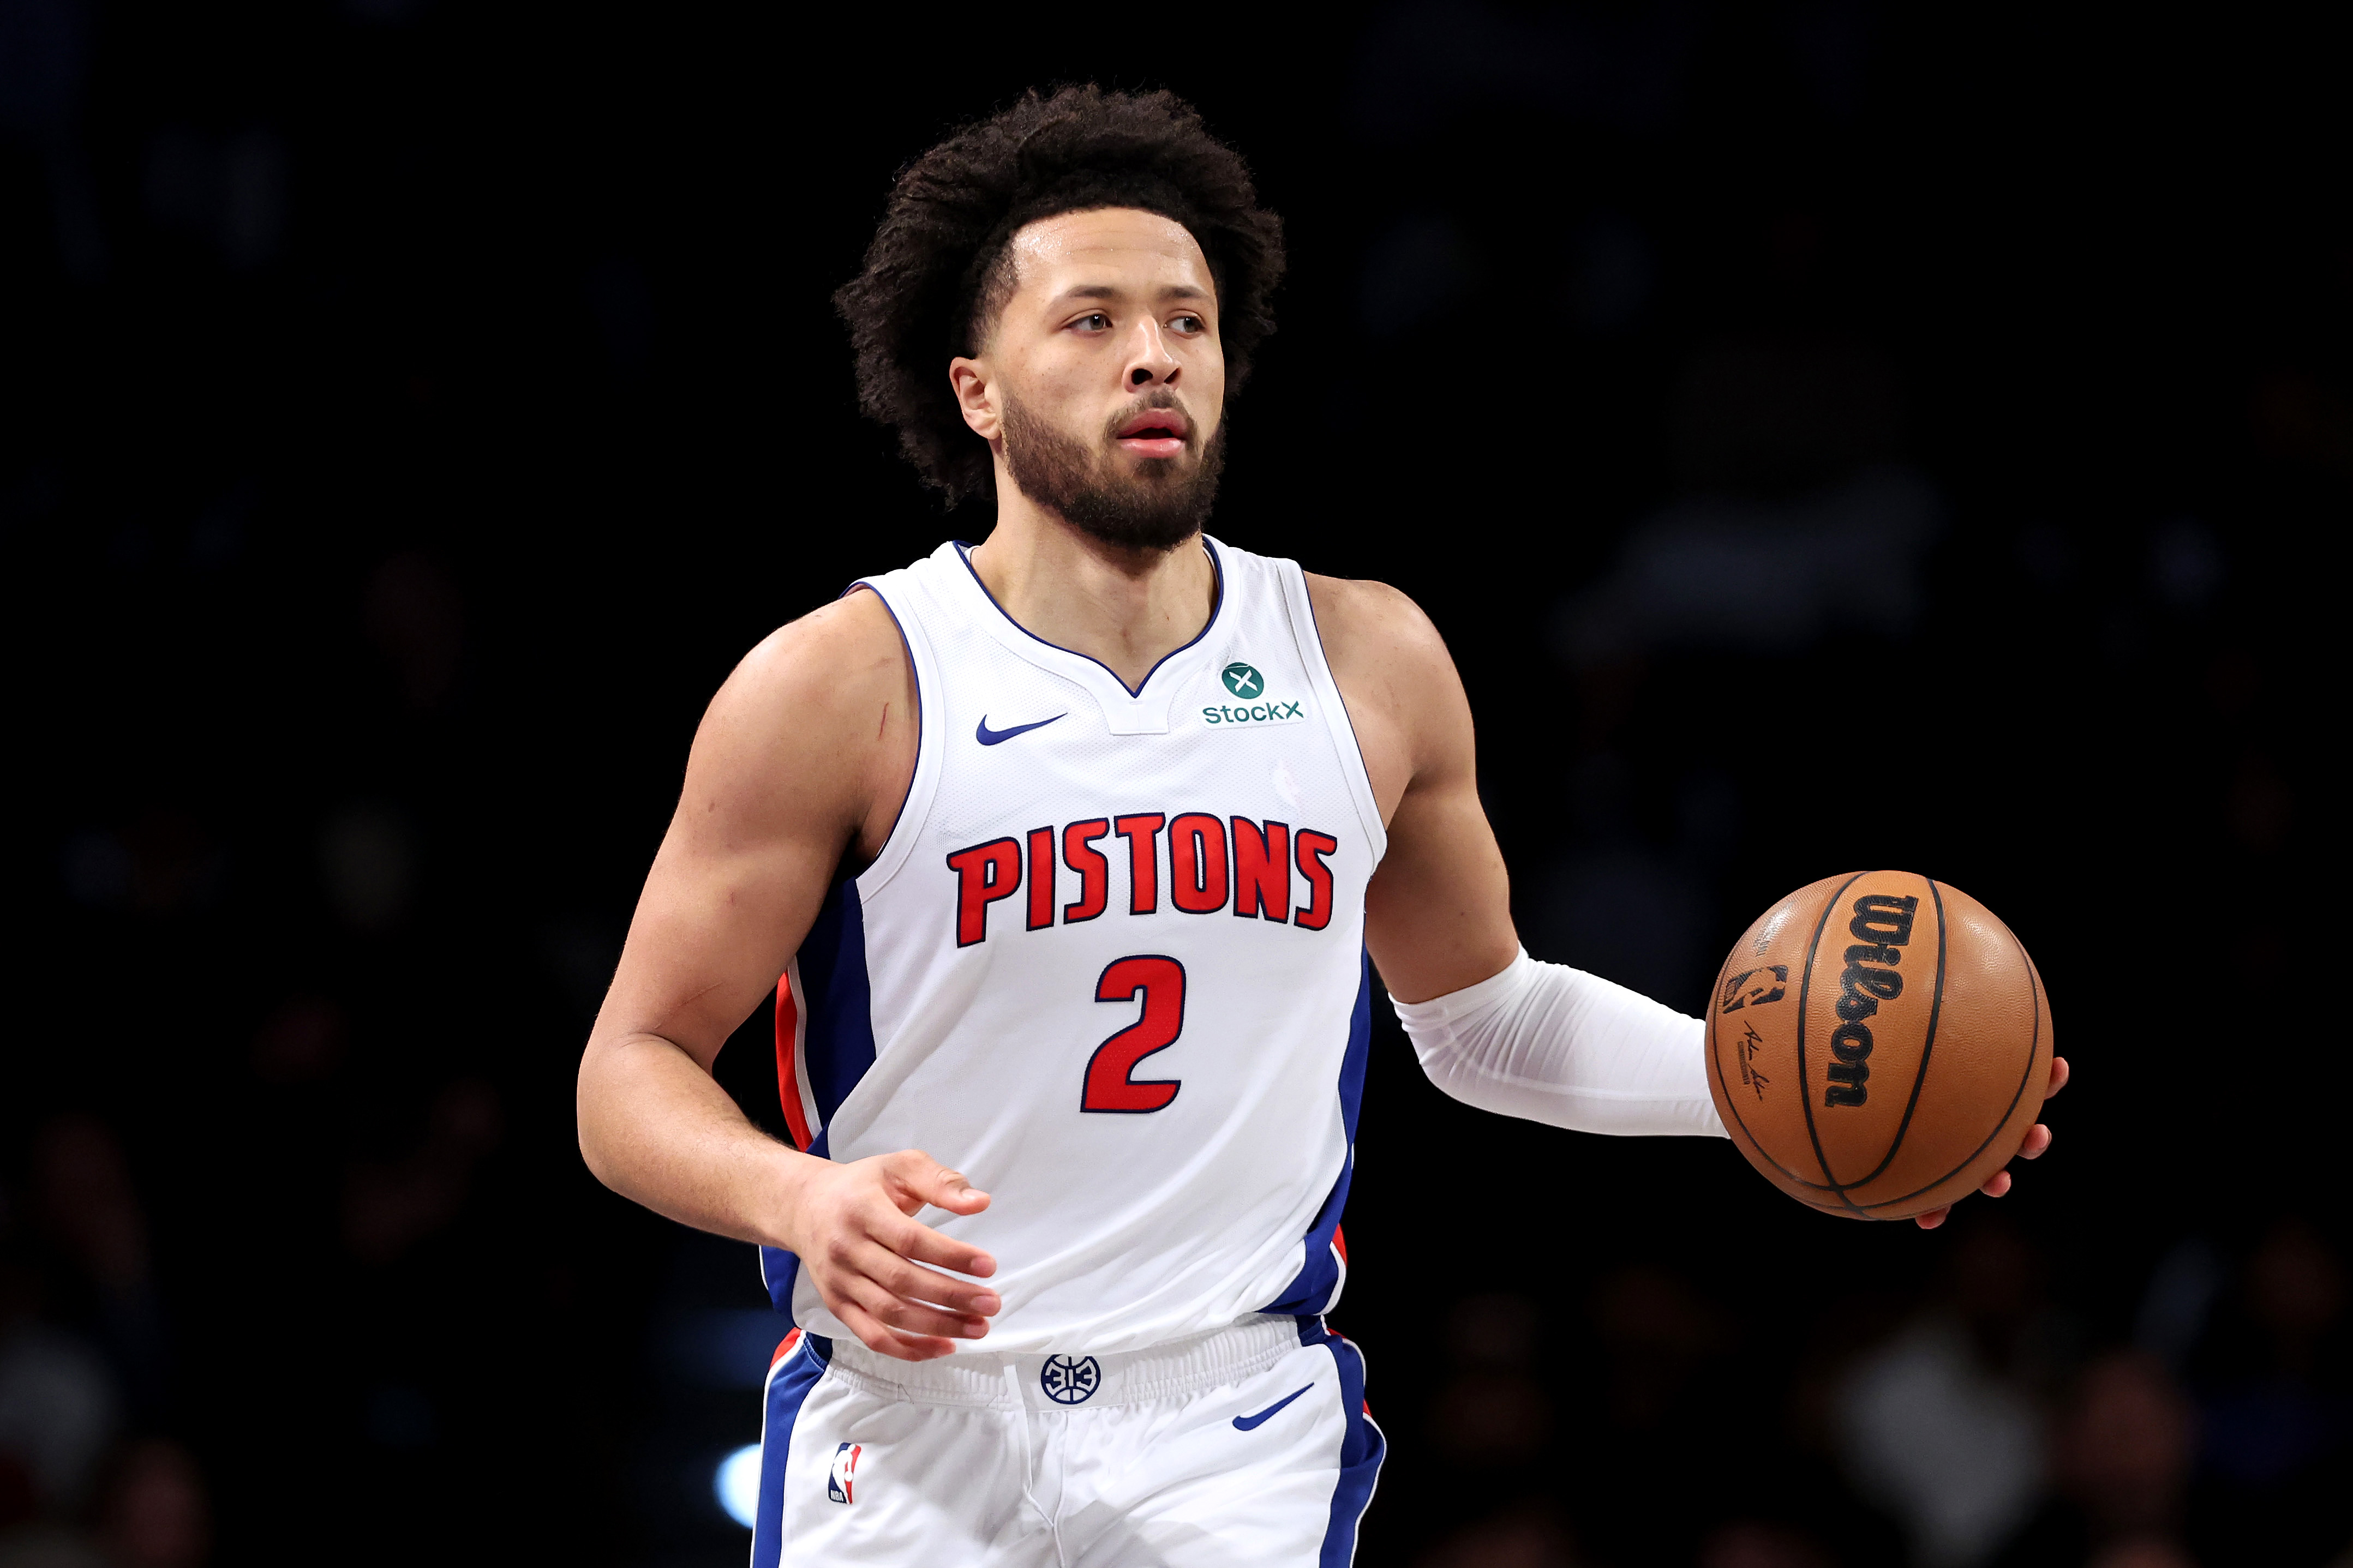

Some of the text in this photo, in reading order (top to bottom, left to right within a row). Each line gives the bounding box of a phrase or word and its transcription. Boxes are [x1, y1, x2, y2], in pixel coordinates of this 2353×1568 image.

[947, 812, 1337, 948] PISTONS
[1080, 954, 1186, 1113] 2
[1825, 894, 1919, 1108] Wilson
[830, 1489, 844, 1502] NBA
